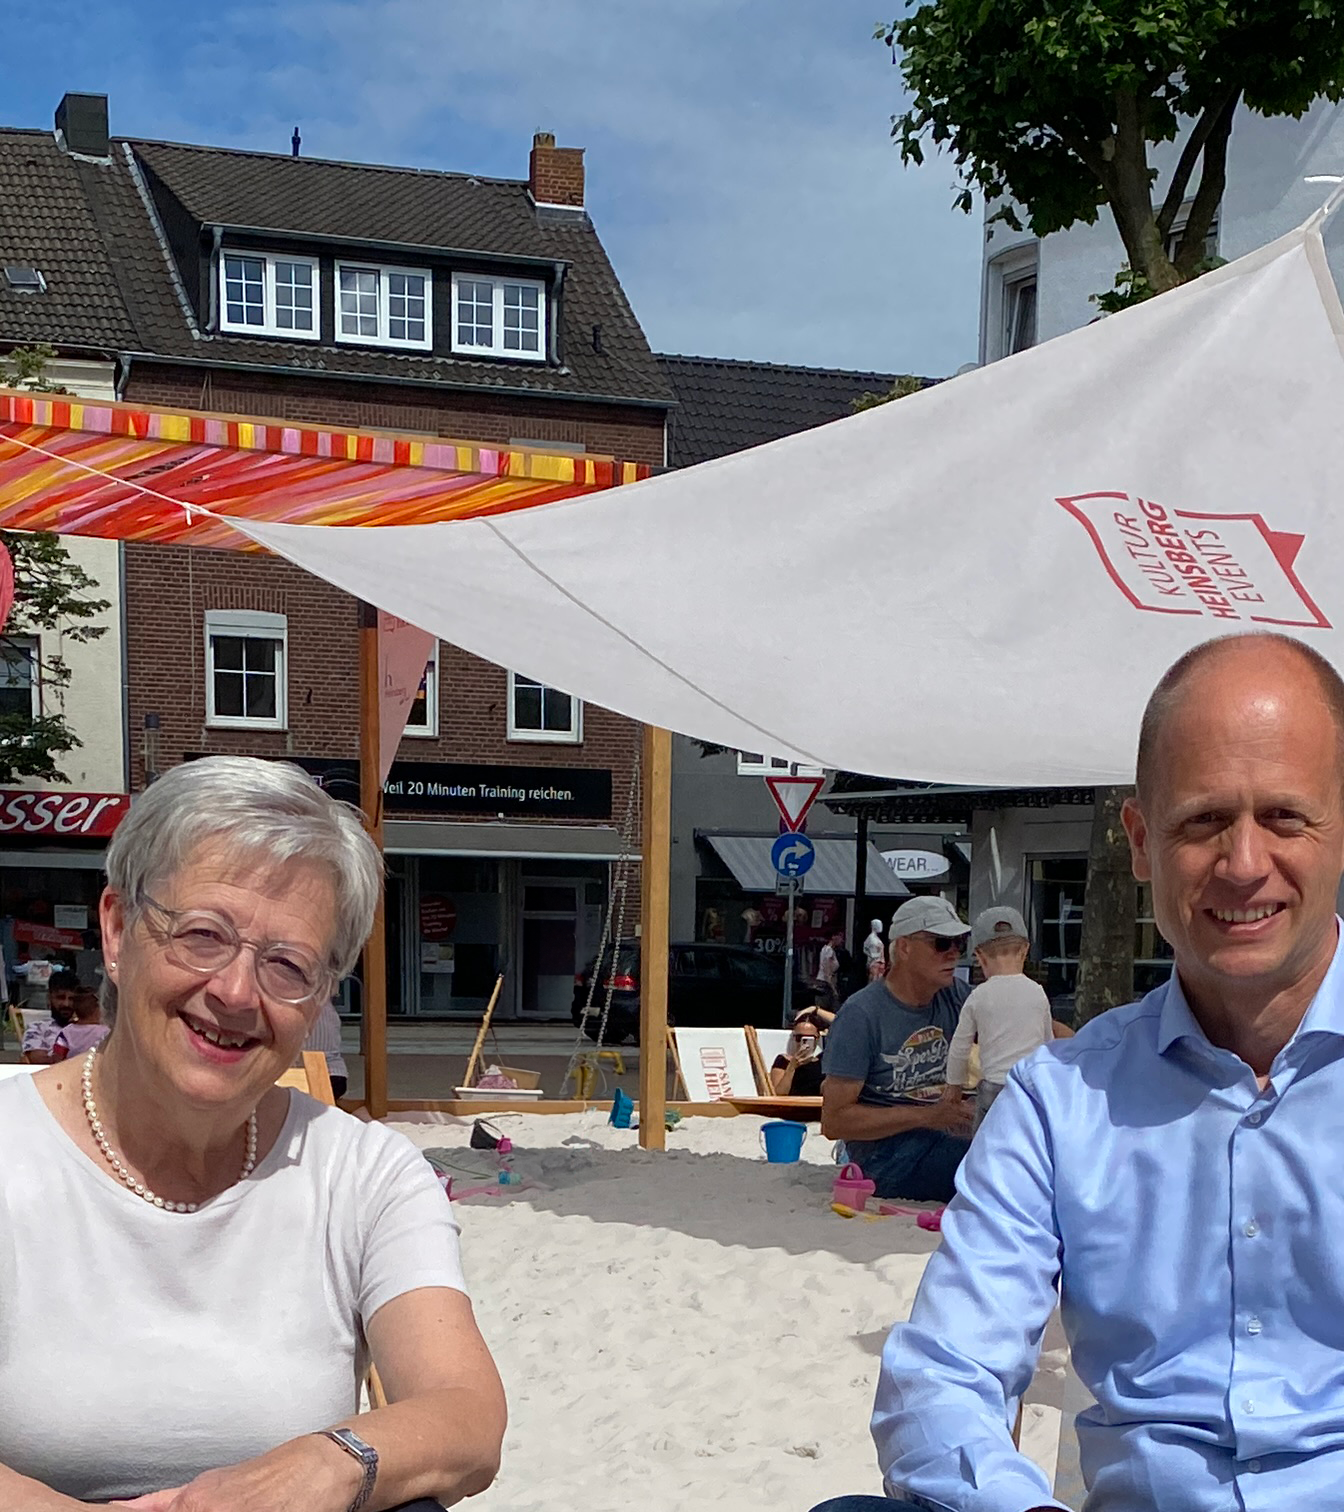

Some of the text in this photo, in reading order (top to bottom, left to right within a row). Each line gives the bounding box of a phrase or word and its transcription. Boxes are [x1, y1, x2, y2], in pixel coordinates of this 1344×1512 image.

[1113, 511, 1187, 596] KULTUR
[1136, 497, 1242, 621] HEINSBERG
[1183, 529, 1265, 603] EVENTS
[407, 779, 424, 796] 20
[427, 781, 476, 798] Minuten
[479, 784, 526, 802] Training
[528, 786, 575, 801] reichen.
